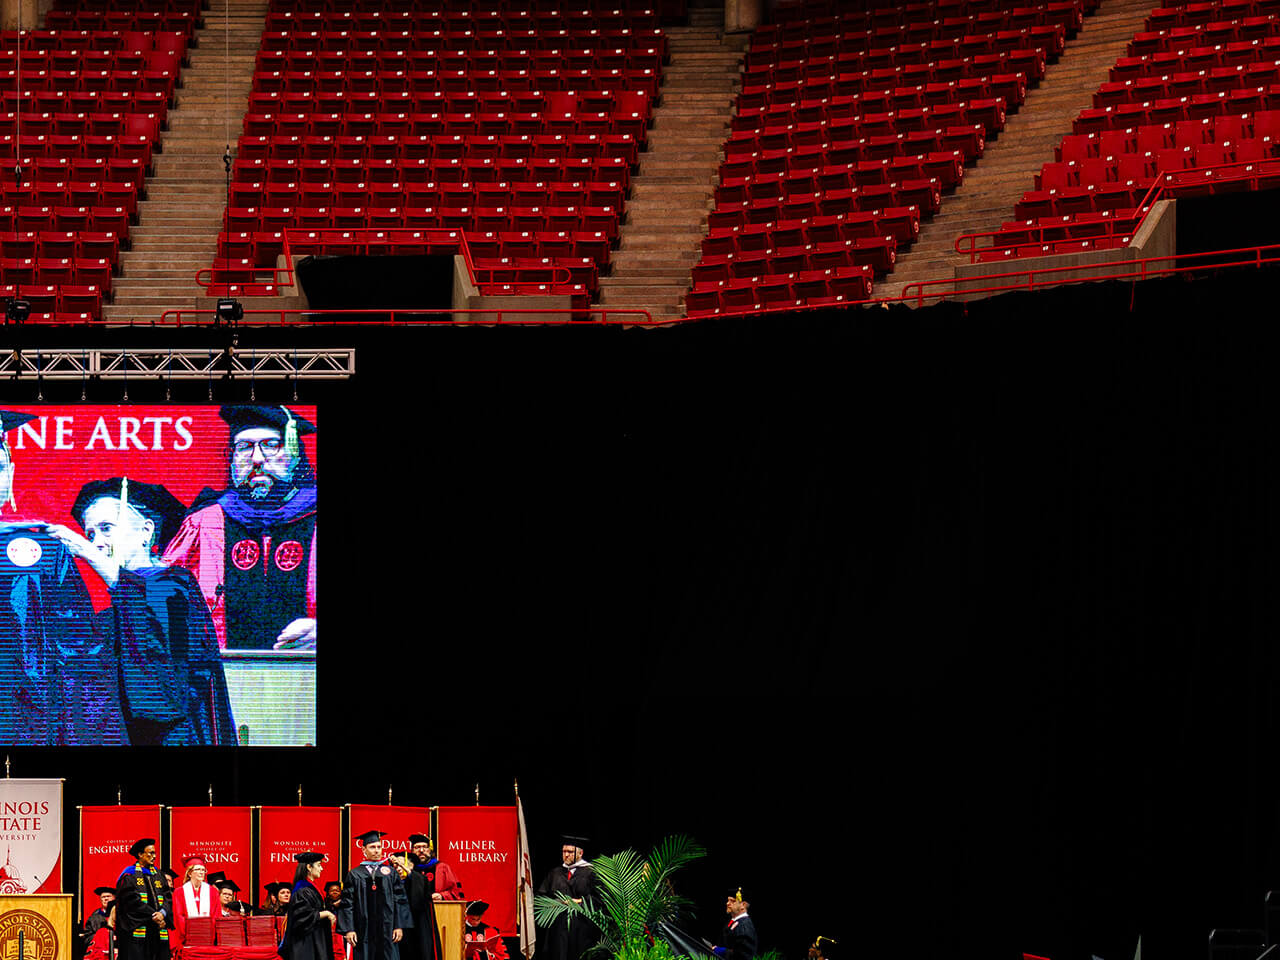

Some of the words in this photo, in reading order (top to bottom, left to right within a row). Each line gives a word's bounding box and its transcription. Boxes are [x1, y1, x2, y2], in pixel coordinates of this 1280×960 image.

[4, 416, 75, 450] NE
[84, 415, 194, 451] ARTS
[88, 844, 133, 855] ENGINEE
[448, 840, 497, 850] MILNER
[270, 852, 298, 863] FINE
[459, 852, 508, 862] LIBRARY
[32, 918, 52, 944] STATE
